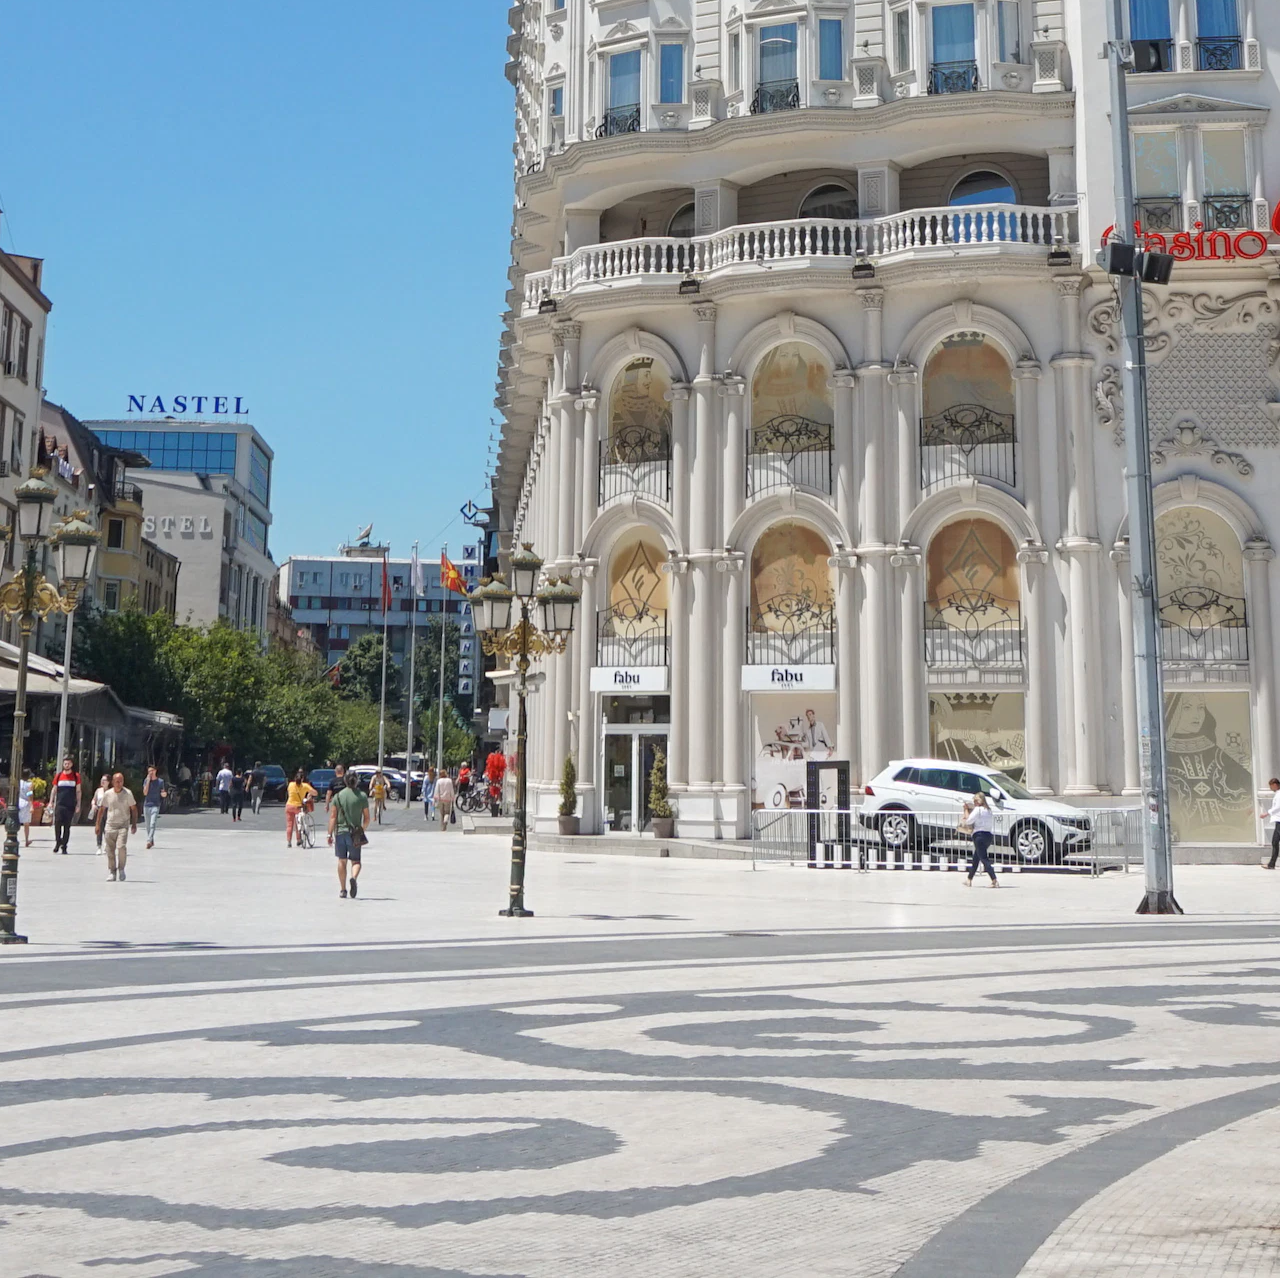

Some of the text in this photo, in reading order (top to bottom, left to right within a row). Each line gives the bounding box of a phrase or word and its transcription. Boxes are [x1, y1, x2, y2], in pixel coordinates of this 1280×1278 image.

[127, 395, 249, 415] NASTEL
[614, 670, 641, 684] fabu
[770, 668, 804, 682] fabu
